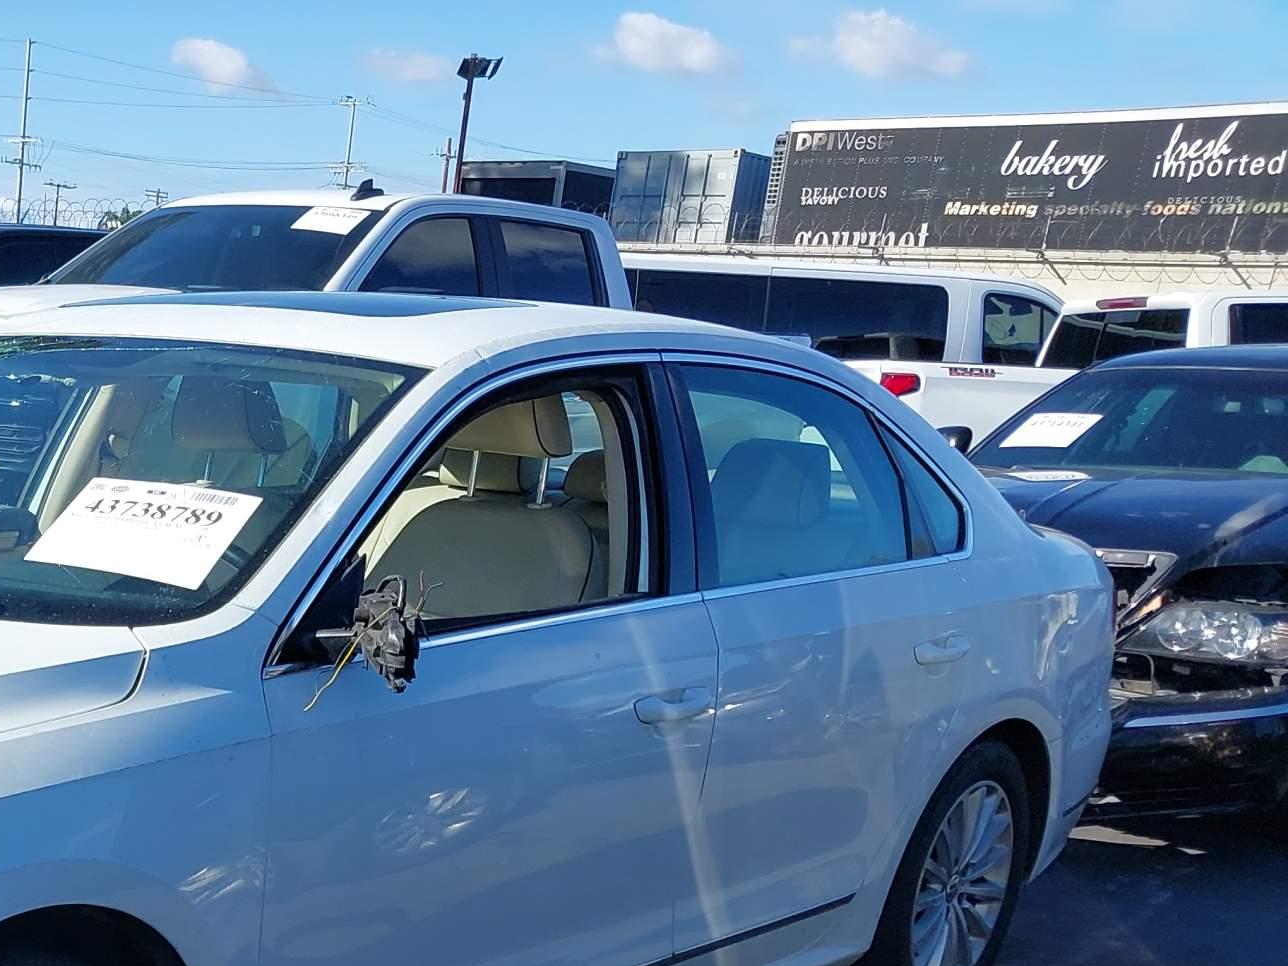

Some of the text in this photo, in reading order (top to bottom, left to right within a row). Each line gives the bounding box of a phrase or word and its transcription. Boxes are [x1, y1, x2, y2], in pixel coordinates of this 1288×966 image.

[1000, 139, 1109, 190] bakery
[1152, 150, 1288, 183] imported
[800, 186, 888, 200] DELICIOUS
[944, 201, 1039, 218] Marketing
[1142, 200, 1202, 216] foods
[85, 498, 224, 527] 43738789
